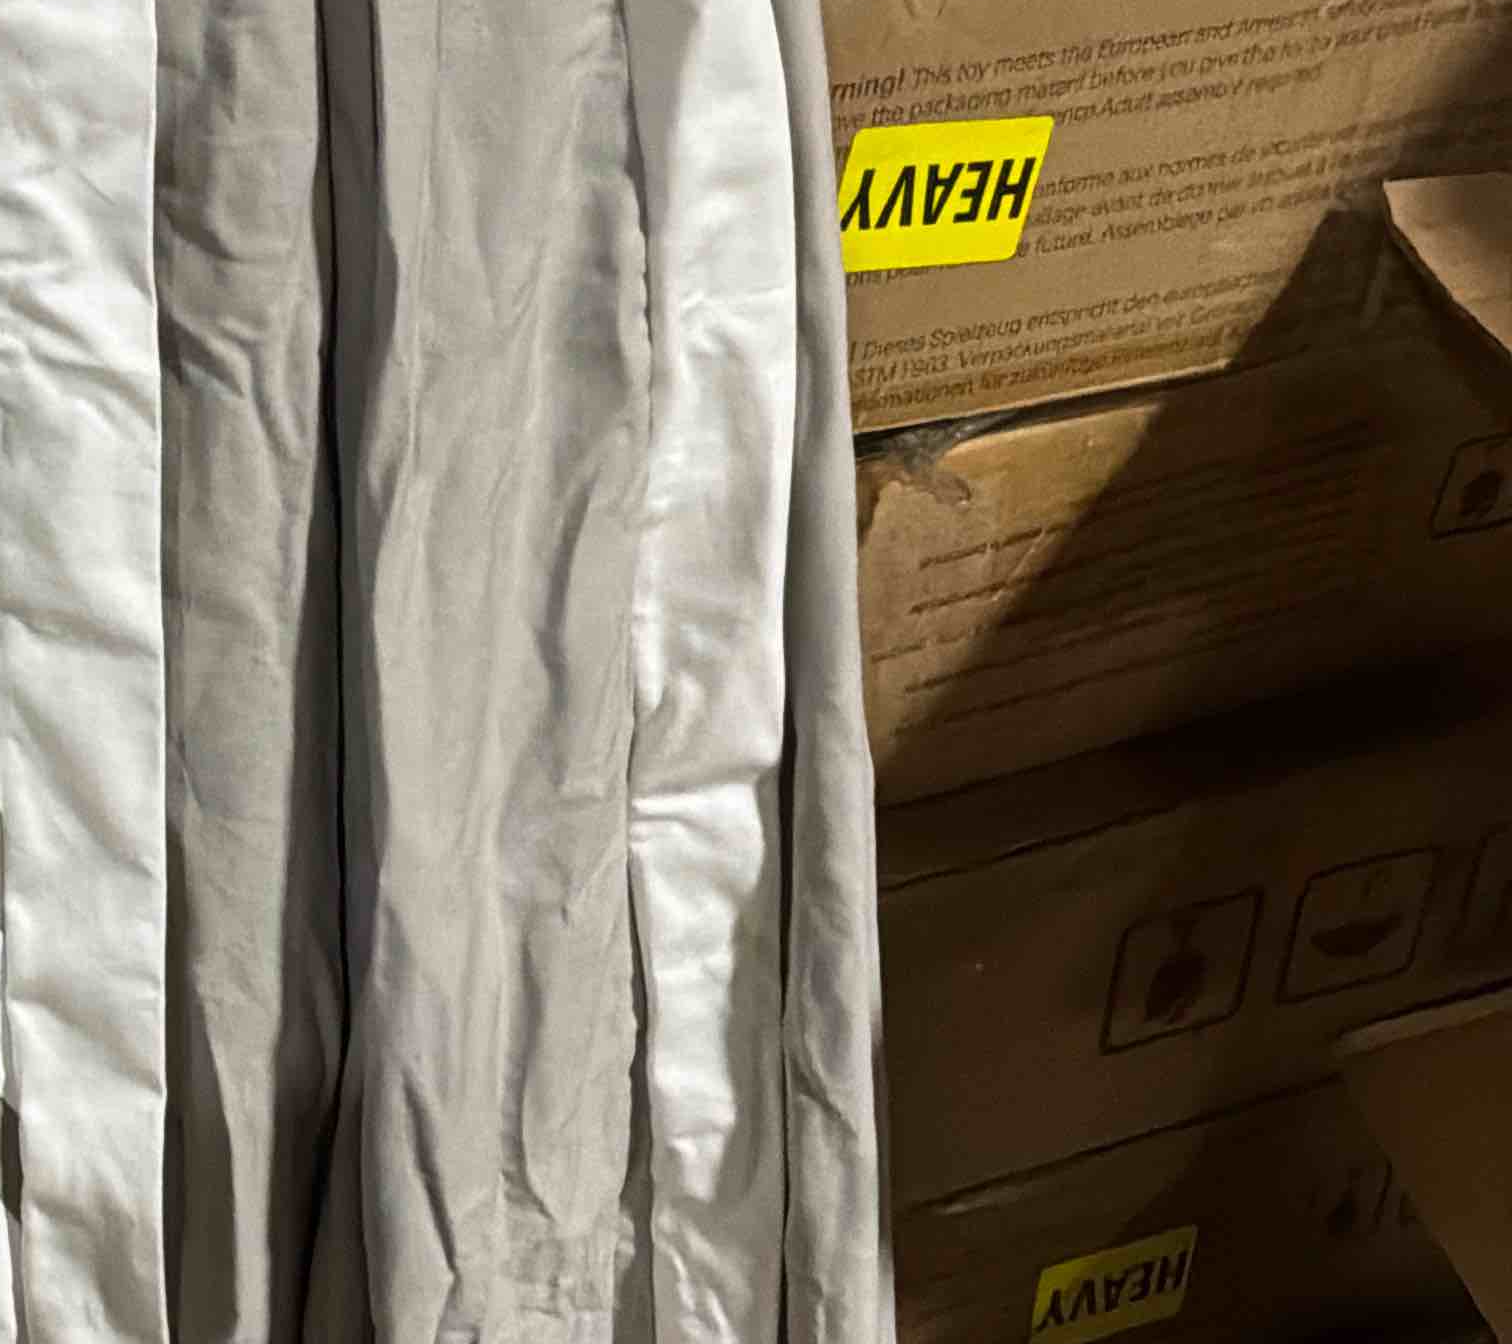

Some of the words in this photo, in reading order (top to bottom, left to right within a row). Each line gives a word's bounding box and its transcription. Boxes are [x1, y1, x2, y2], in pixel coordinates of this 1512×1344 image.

[993, 50, 1055, 74] meets
[839, 156, 1037, 233] HEAVY
[1035, 1250, 1188, 1332] HEAVY
